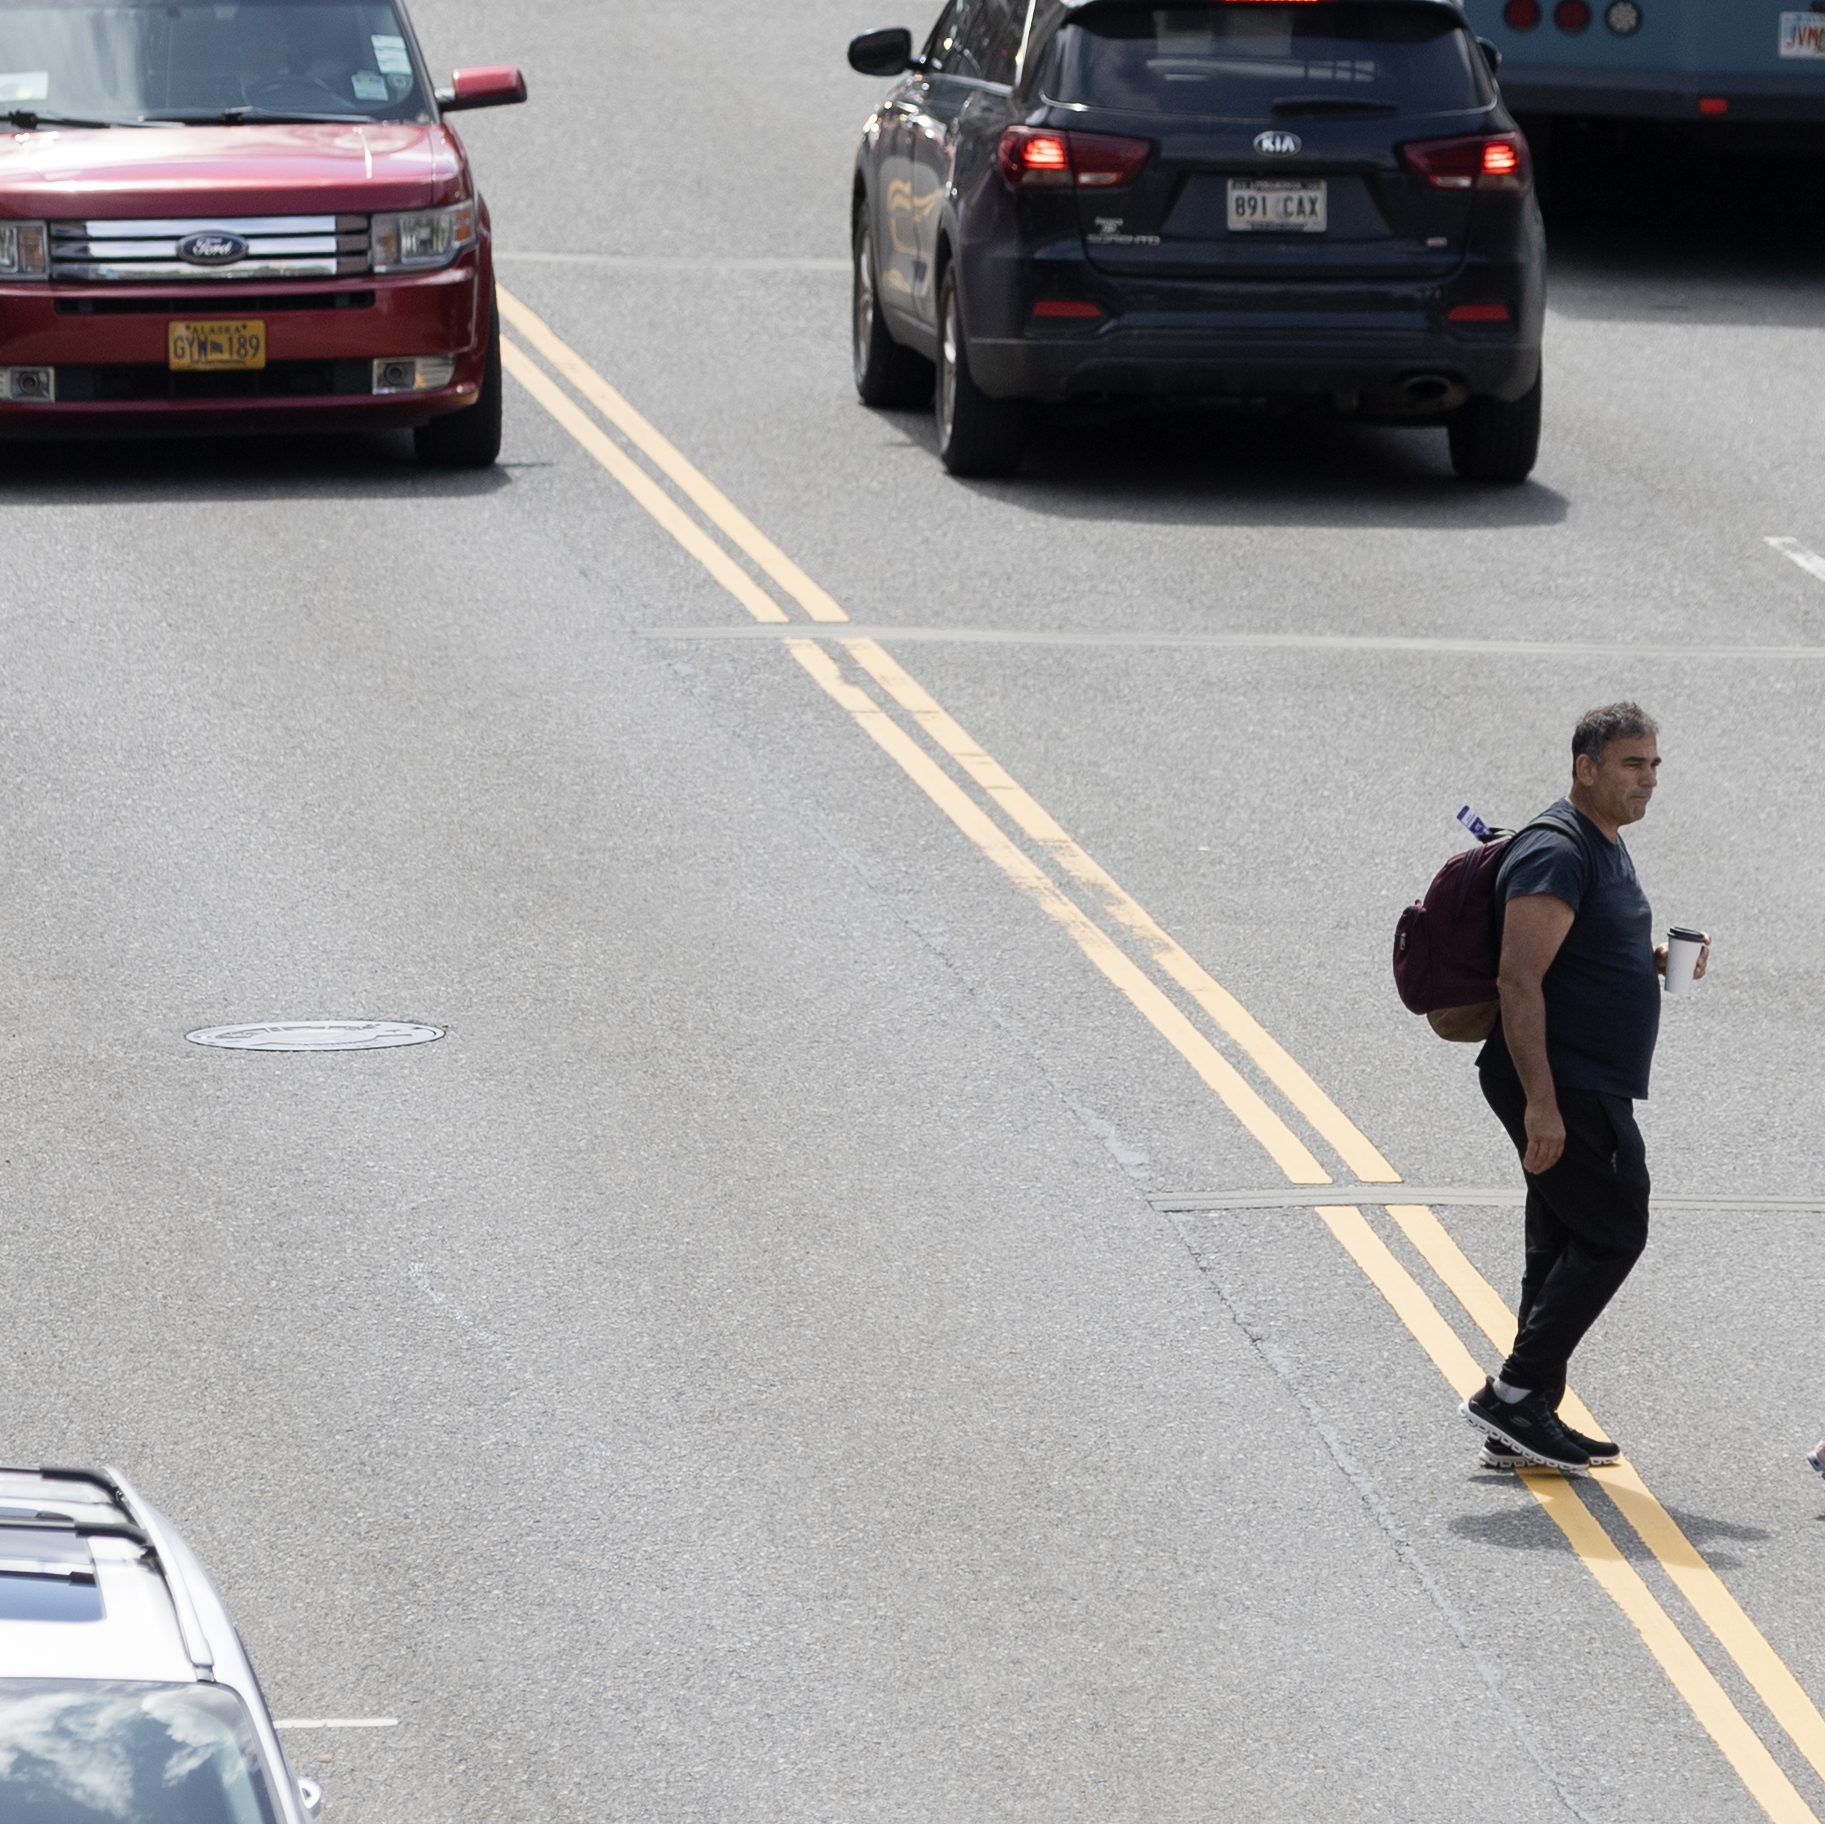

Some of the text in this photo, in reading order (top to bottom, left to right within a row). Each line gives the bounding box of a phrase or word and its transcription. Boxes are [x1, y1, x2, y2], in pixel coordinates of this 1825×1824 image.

[1262, 135, 1297, 153] KIA
[1235, 195, 1319, 218] 891 CAX
[192, 236, 234, 257] Ford
[227, 334, 261, 359] 189
